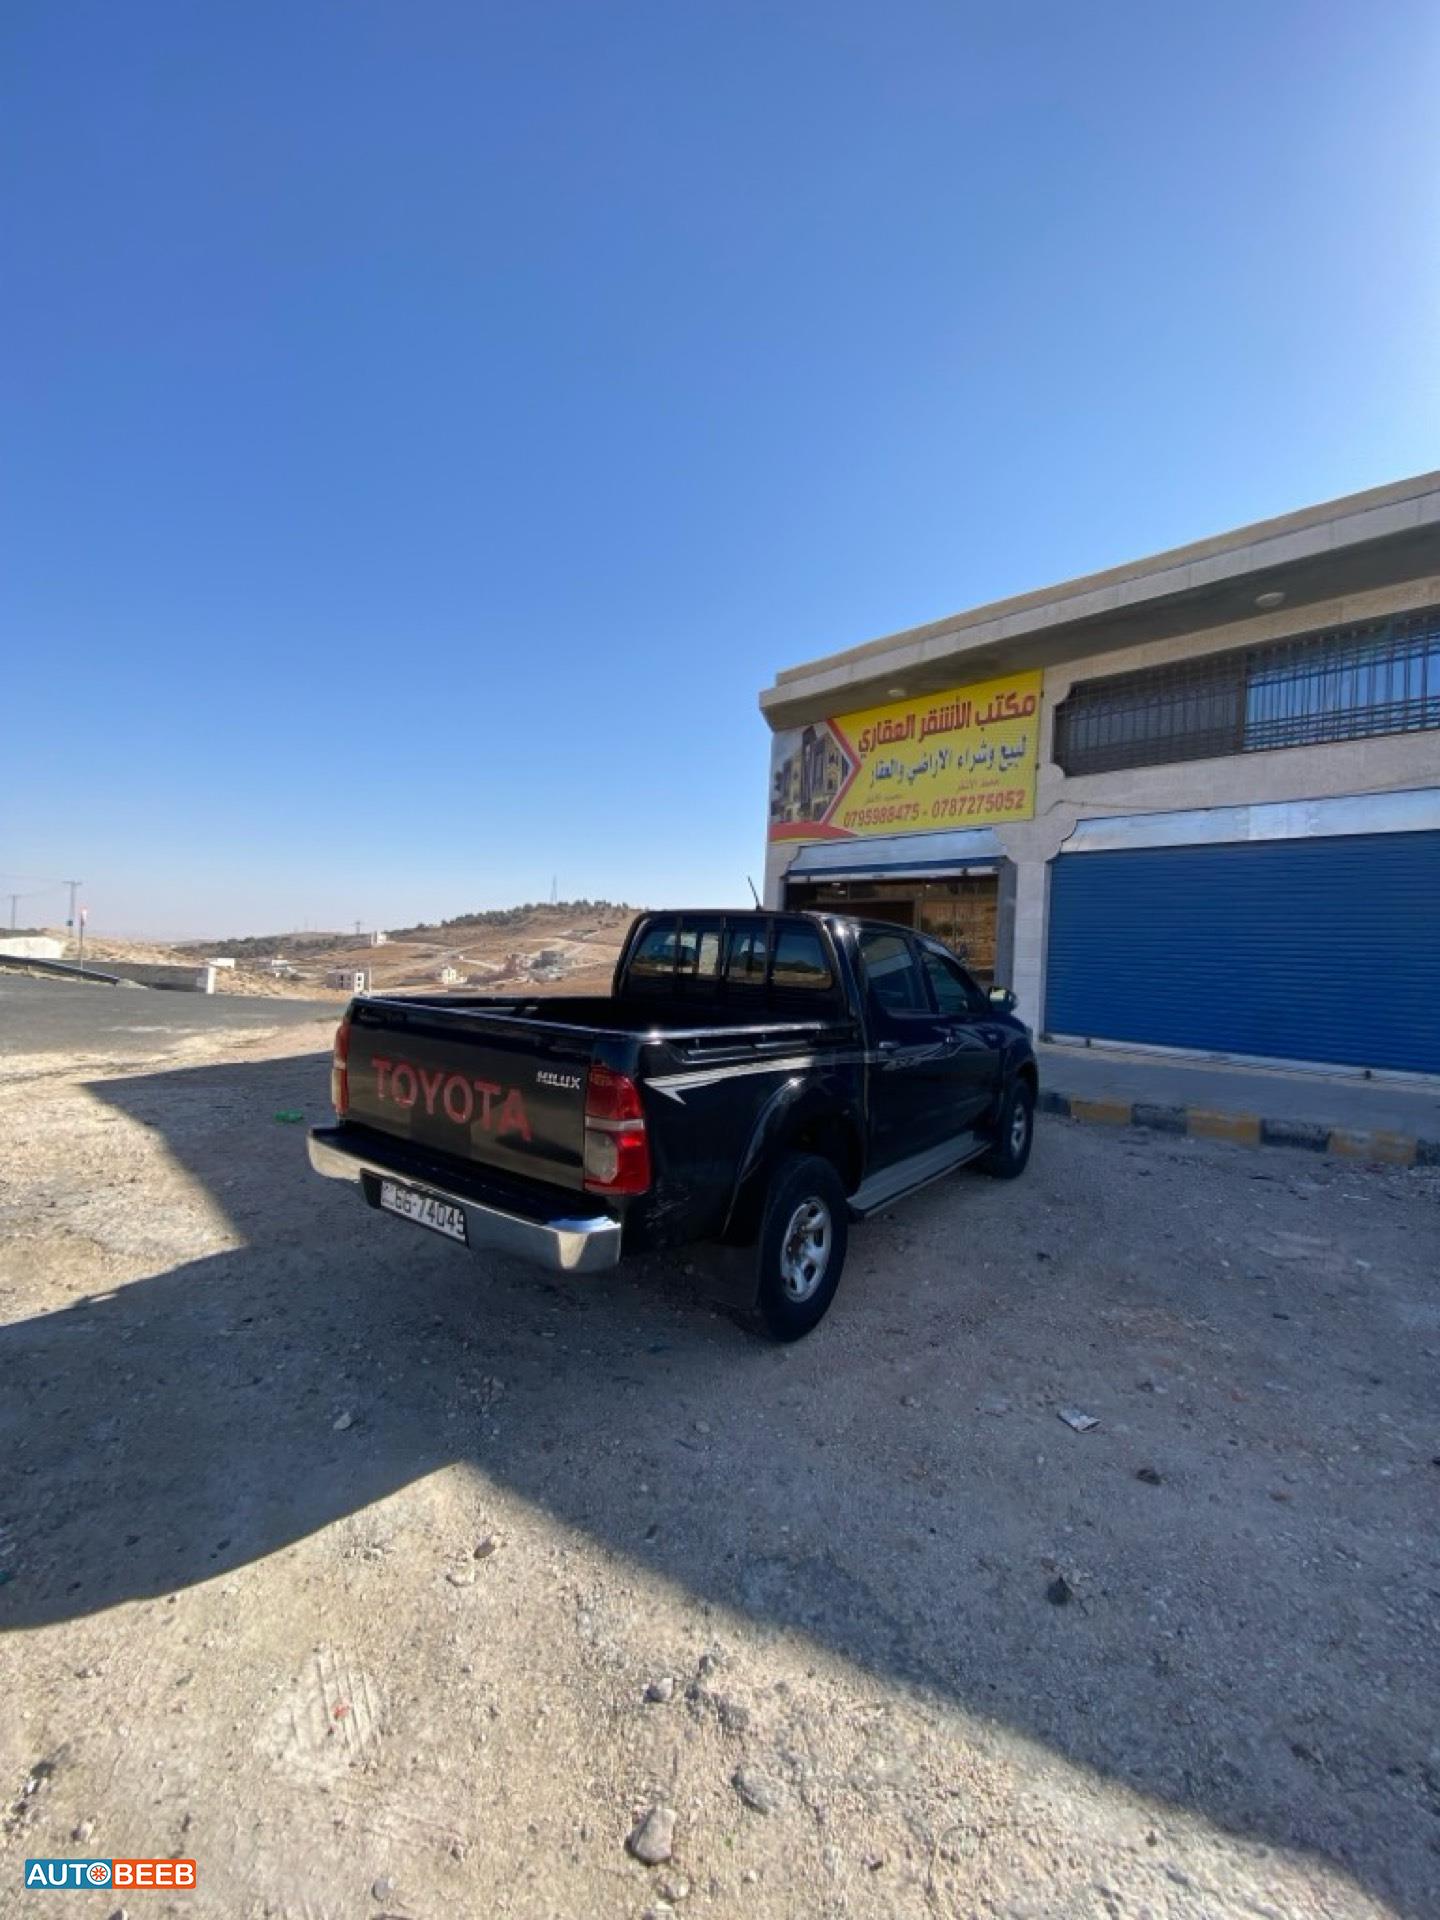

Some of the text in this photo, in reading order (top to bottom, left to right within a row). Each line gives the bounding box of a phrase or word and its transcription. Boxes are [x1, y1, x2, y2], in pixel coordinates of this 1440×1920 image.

[857, 691, 1036, 759] مكتب الأشقر العقاري
[957, 740, 995, 773] وشراء
[371, 1055, 534, 1142] TOYOTA
[536, 1071, 582, 1091] HILUX
